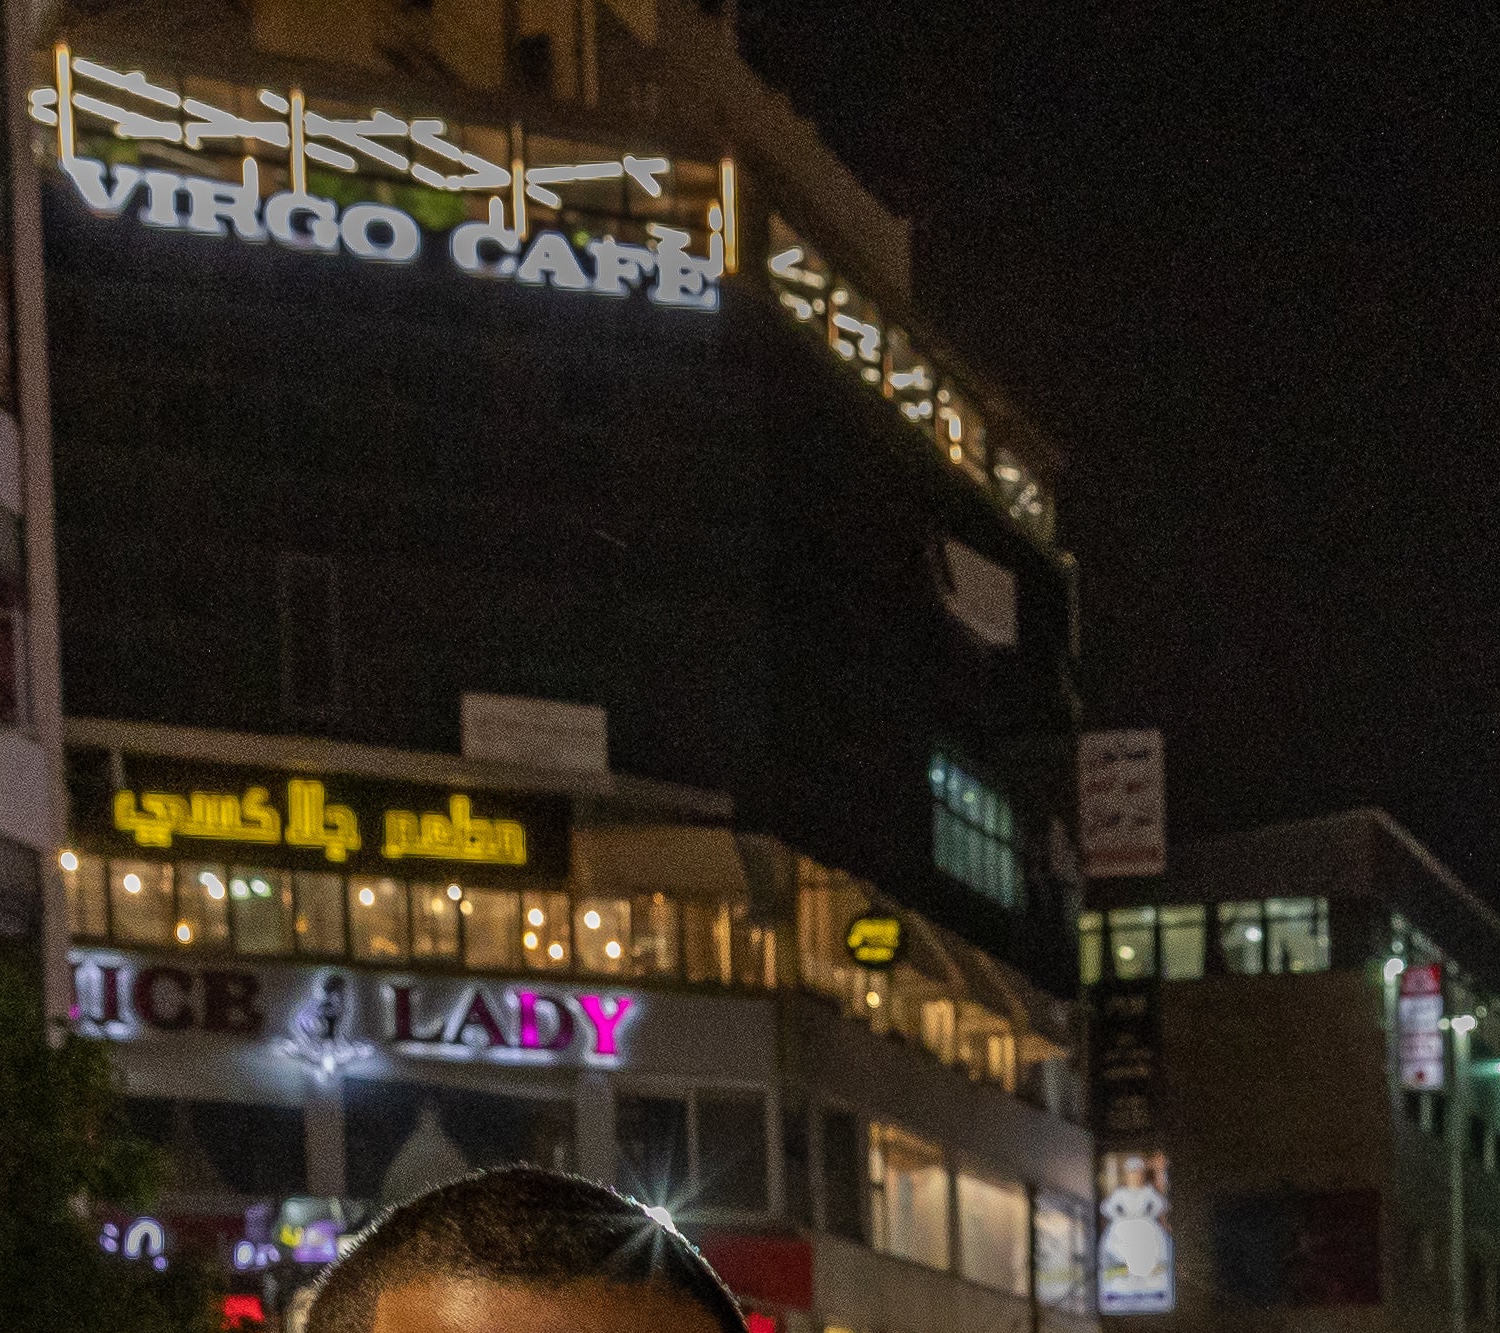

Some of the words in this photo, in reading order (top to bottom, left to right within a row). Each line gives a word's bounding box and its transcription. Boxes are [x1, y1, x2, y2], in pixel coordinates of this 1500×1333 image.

[60, 156, 422, 264] VIRGO
[112, 777, 363, 863] جلاكسي
[381, 792, 529, 867] مطعم
[384, 982, 638, 1062] LADY
